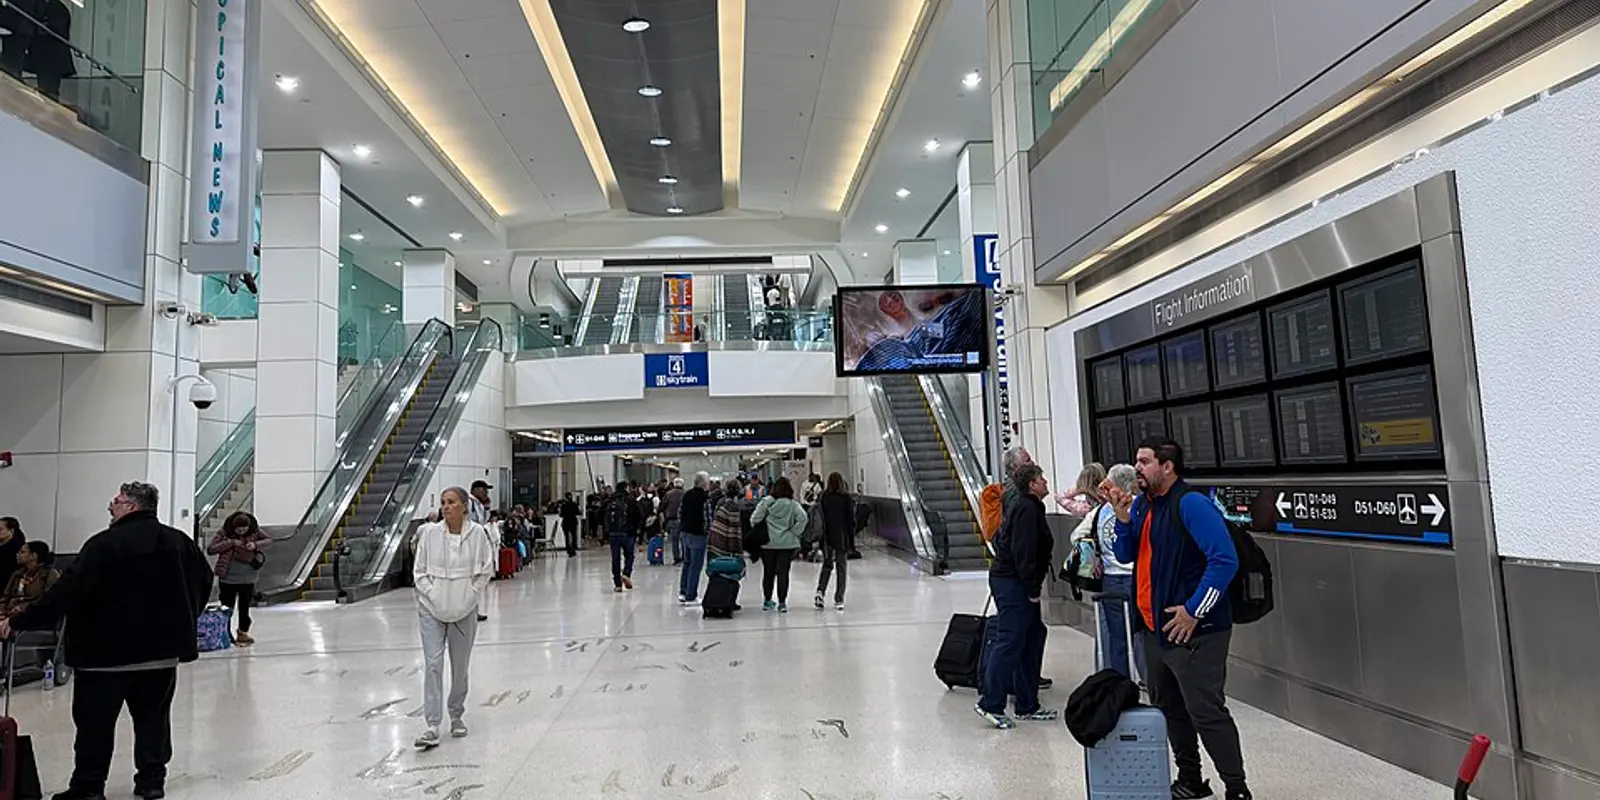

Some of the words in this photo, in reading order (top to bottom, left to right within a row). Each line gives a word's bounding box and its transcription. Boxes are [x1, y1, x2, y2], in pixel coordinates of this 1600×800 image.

[208, 141, 223, 238] NEWS
[1155, 298, 1183, 326] Flight
[1183, 274, 1250, 314] Information
[672, 360, 681, 373] 4
[667, 374, 698, 385] skytrain
[1310, 507, 1338, 520] E1-E33
[1354, 500, 1397, 516] D51-D60
